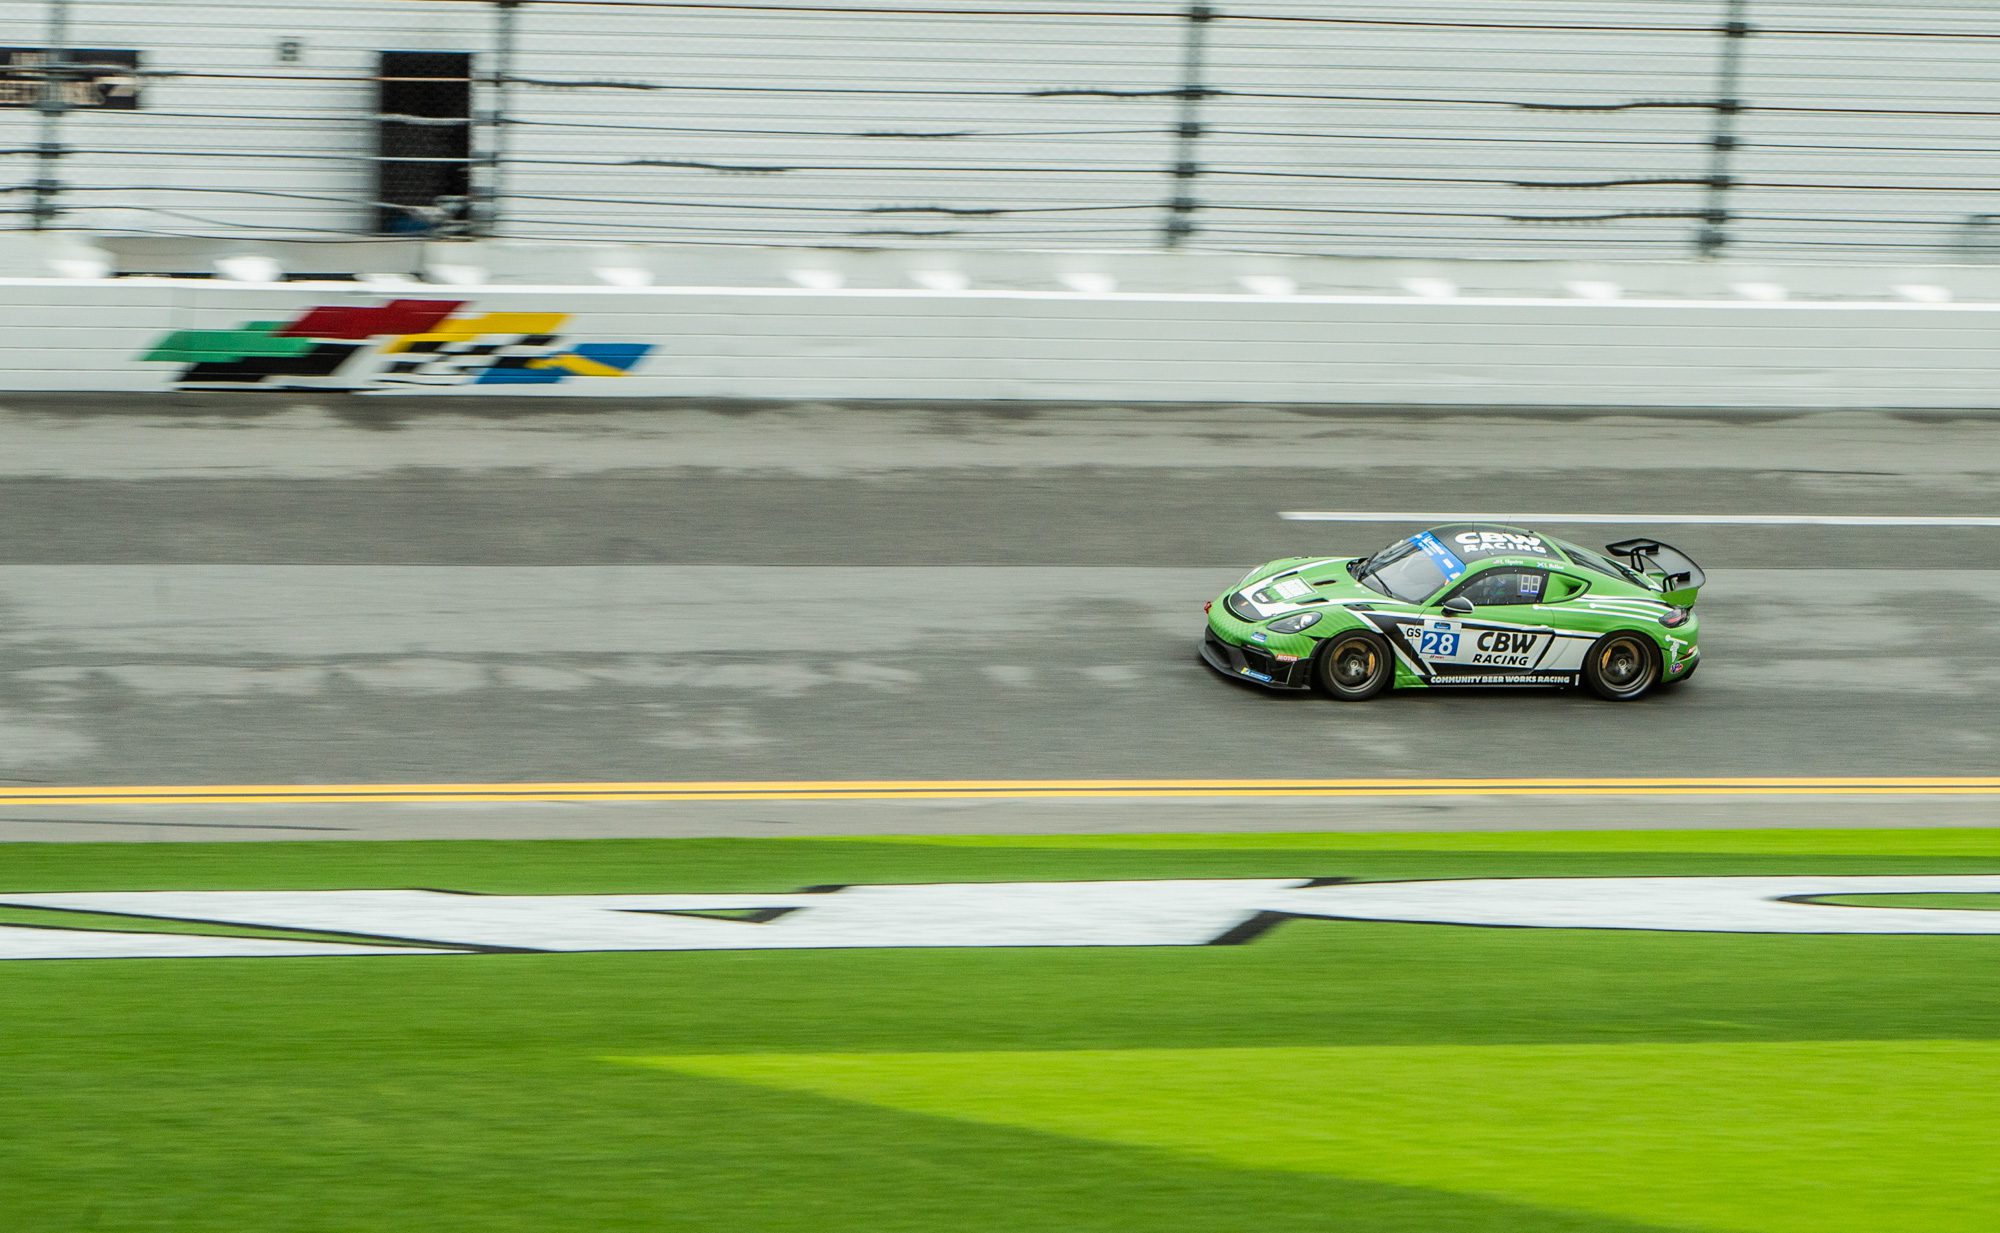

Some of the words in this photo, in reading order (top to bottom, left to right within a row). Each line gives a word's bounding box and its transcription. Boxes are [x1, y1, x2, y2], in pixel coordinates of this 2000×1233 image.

[1455, 531, 1541, 546] CBW
[1463, 543, 1547, 554] RACING
[1406, 628, 1421, 638] GS
[1422, 633, 1453, 655] 28
[1476, 632, 1537, 654] CBW
[1472, 654, 1529, 666] RACING
